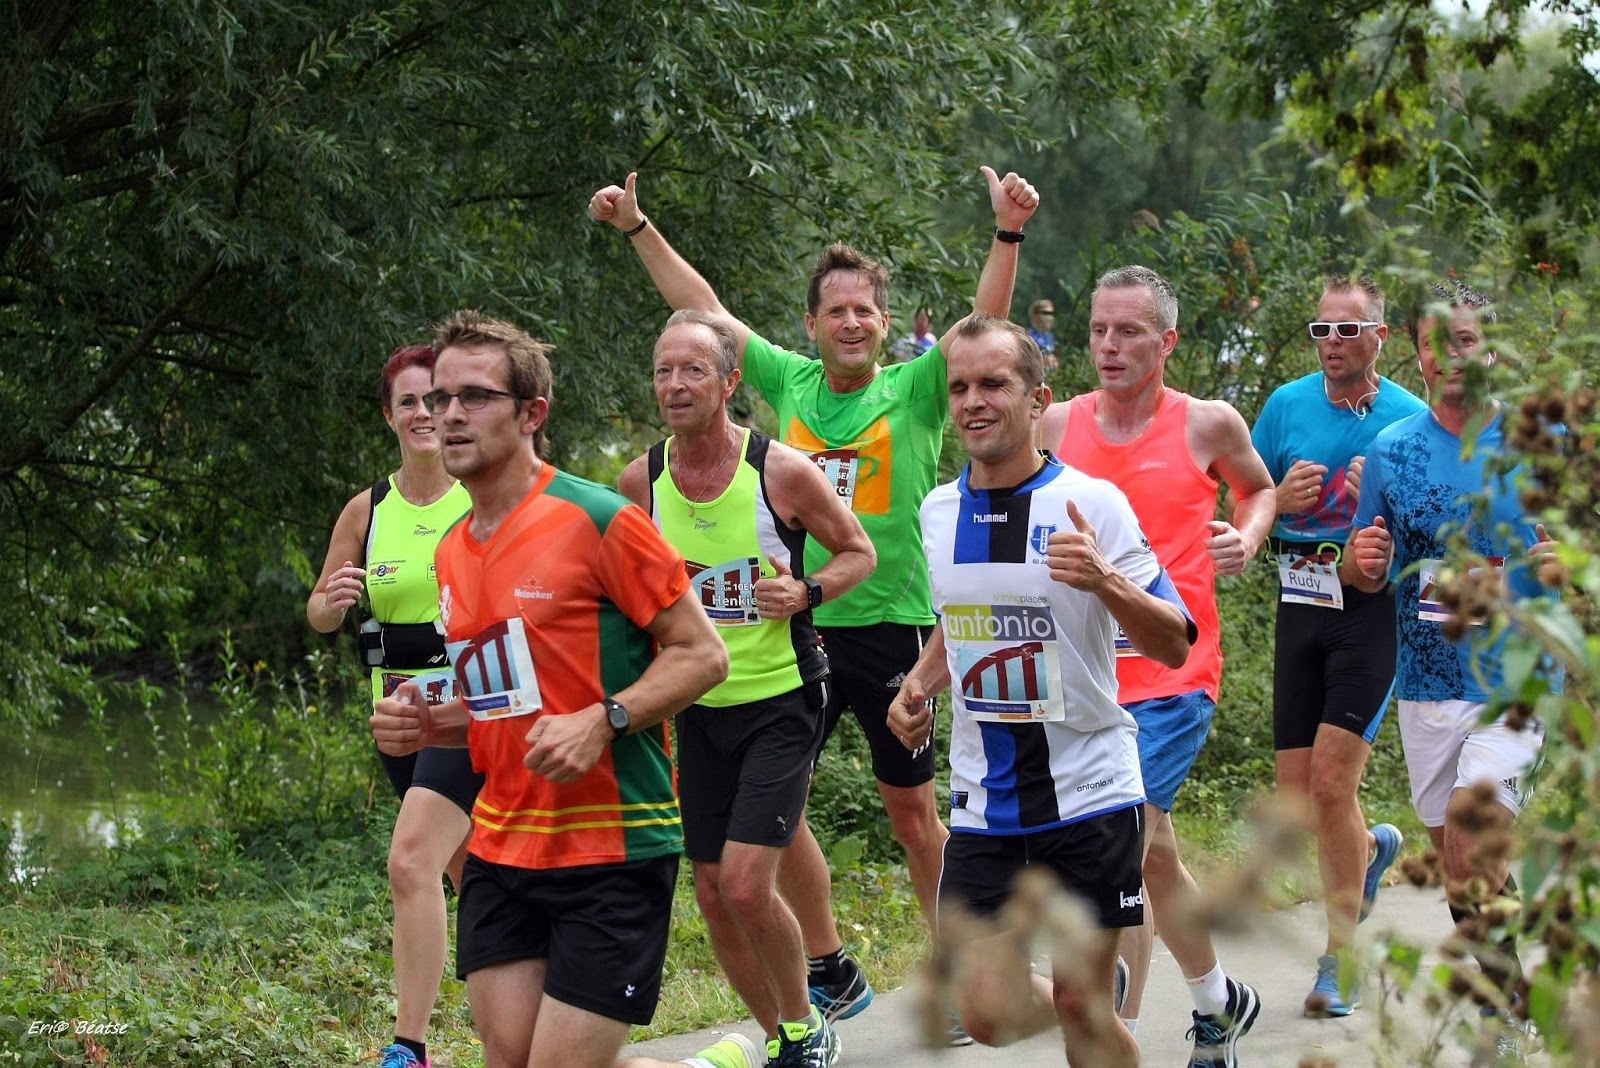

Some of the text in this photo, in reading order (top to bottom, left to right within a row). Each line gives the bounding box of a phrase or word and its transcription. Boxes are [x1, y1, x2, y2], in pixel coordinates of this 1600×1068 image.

[973, 511, 1008, 523] hummel
[1288, 572, 1321, 592] Rudy
[514, 588, 553, 599] Heineken
[712, 594, 758, 606] Henkie
[947, 609, 1052, 638] antonio
[435, 694, 457, 702] 10EM
[1076, 777, 1114, 792] antonio.nl
